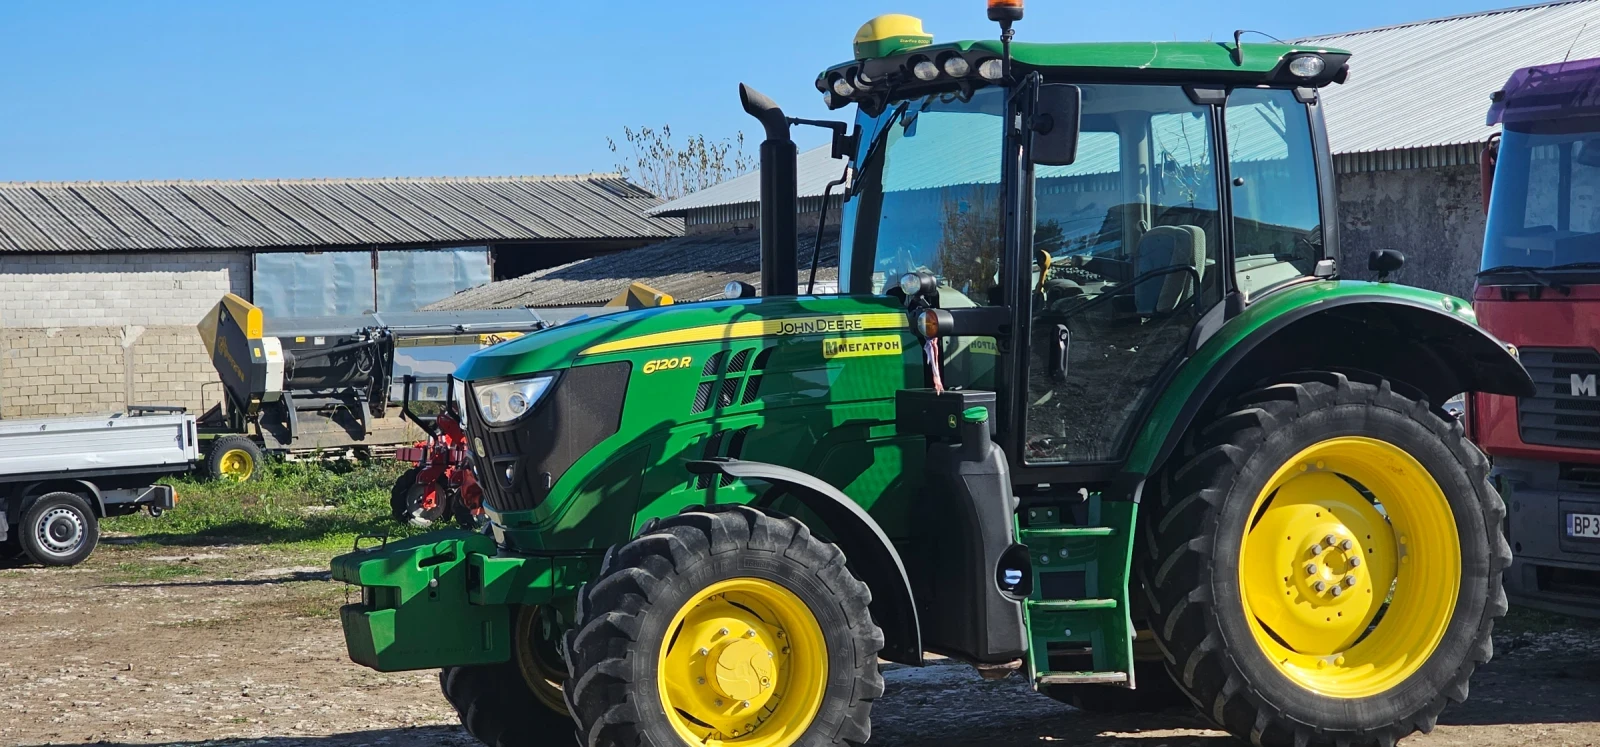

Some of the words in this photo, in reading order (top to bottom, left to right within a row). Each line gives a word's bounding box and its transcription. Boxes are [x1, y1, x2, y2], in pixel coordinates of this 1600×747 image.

[776, 321, 814, 334] JOHN
[816, 319, 862, 331] DEERE
[838, 341, 900, 353] МЕГАТРОН
[1575, 516, 1590, 534] BP
